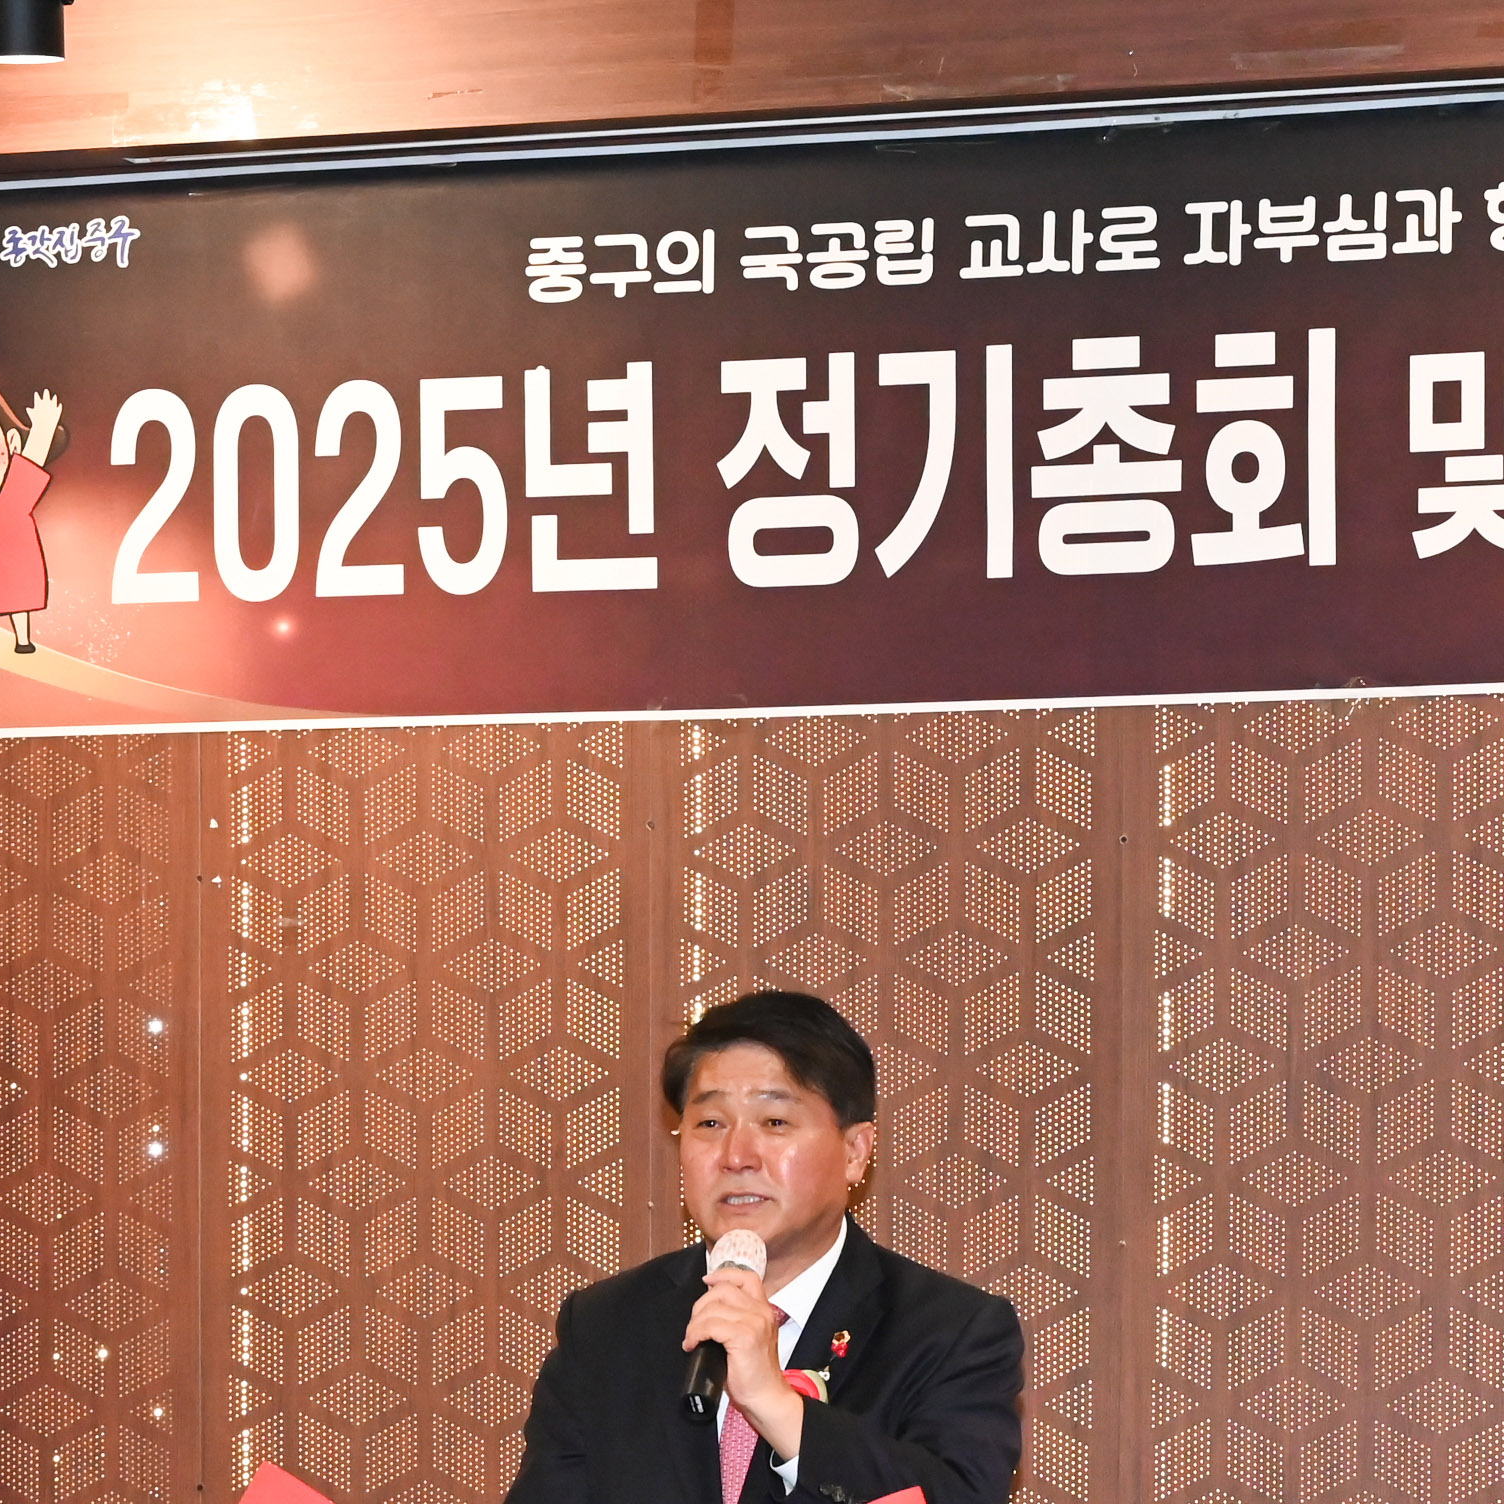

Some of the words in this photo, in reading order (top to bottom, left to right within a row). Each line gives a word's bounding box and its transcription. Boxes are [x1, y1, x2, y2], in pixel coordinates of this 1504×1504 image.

[525, 229, 714, 303] 중구의
[740, 218, 934, 290] 국공립
[960, 206, 1160, 278] 교사로
[1184, 187, 1462, 265] 자부심과
[111, 362, 657, 604] 2025년
[717, 328, 1336, 587] 정기총회
